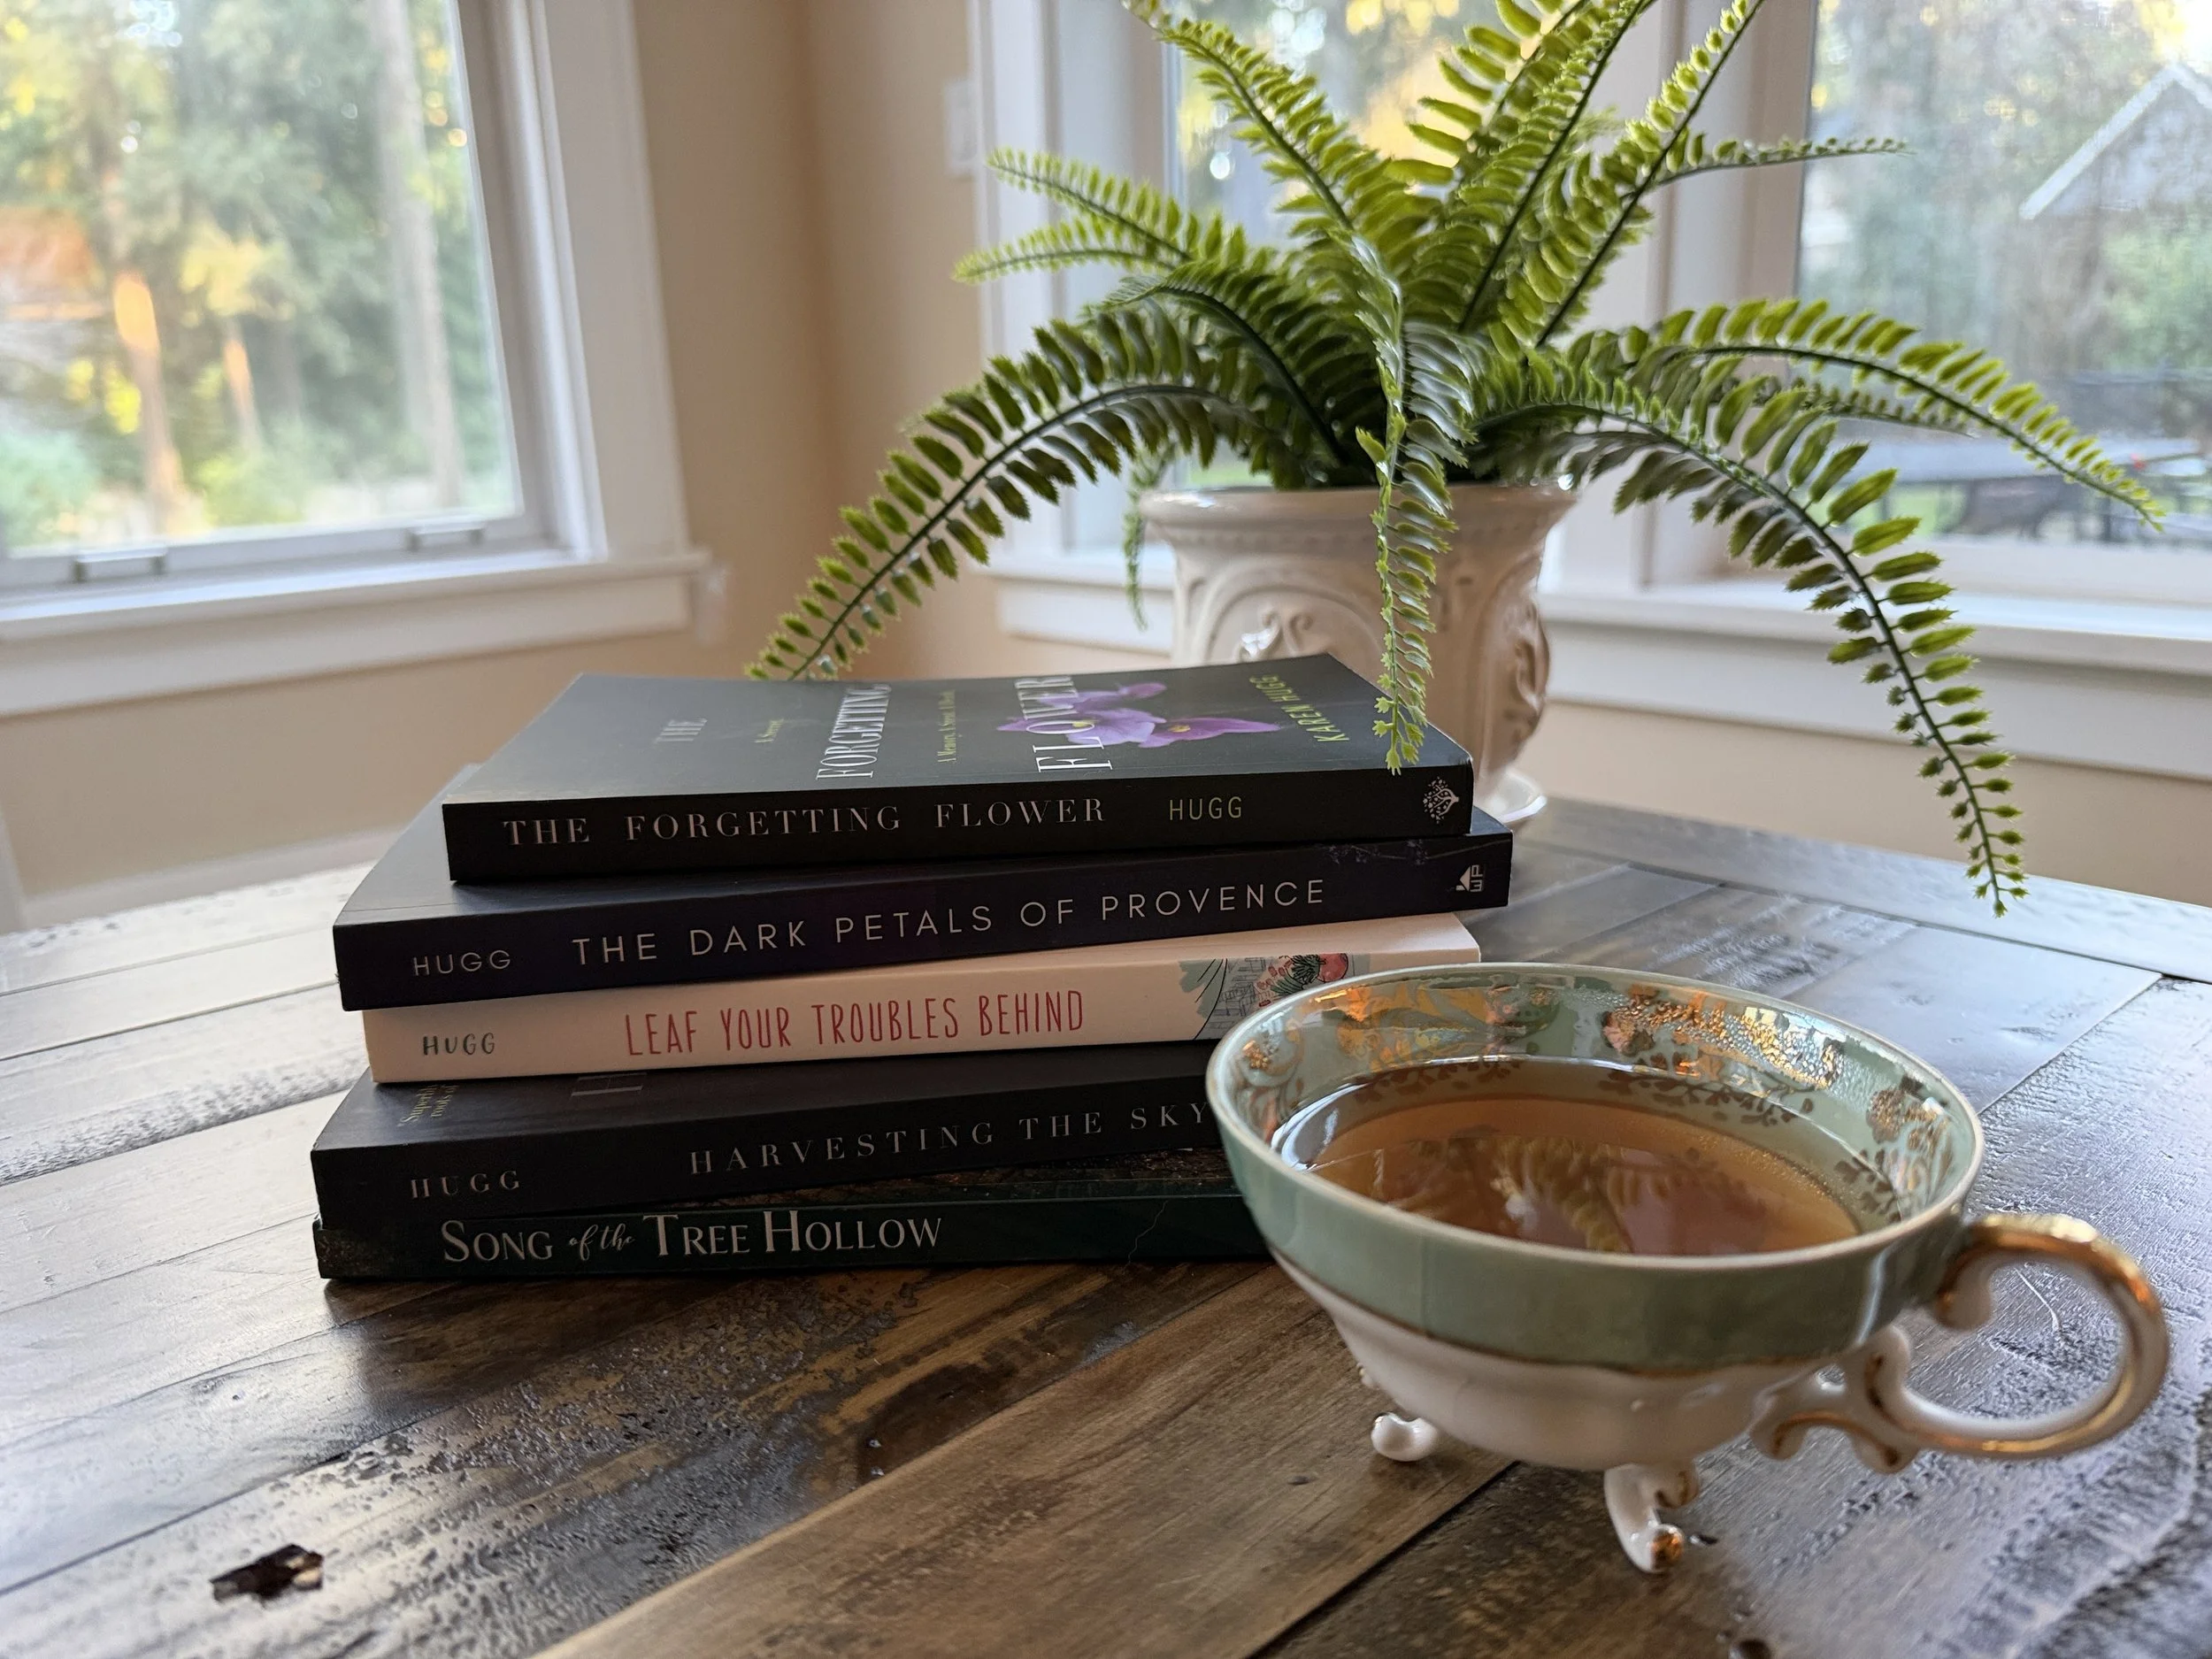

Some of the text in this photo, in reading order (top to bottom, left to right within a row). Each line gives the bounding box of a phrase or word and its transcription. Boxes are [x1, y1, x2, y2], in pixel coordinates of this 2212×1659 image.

[815, 683, 892, 780] FORGETTING
[1014, 675, 1113, 773] FLOWER
[1248, 674, 1350, 742] KAREN HUGG
[503, 795, 1244, 846] THE FORGETTING FLOWER HUGG
[412, 878, 1326, 977] HUGG THE DARK PETALS OF PROVENCE
[421, 989, 1085, 1057] HUGG LEAF YOUR TROUBLES BEHIND
[410, 1101, 1208, 1200] HUGG HARVESTING THE SKY
[441, 1218, 554, 1263] SONG
[642, 1213, 751, 1256] TREE
[762, 1209, 942, 1253] HOLLOW
